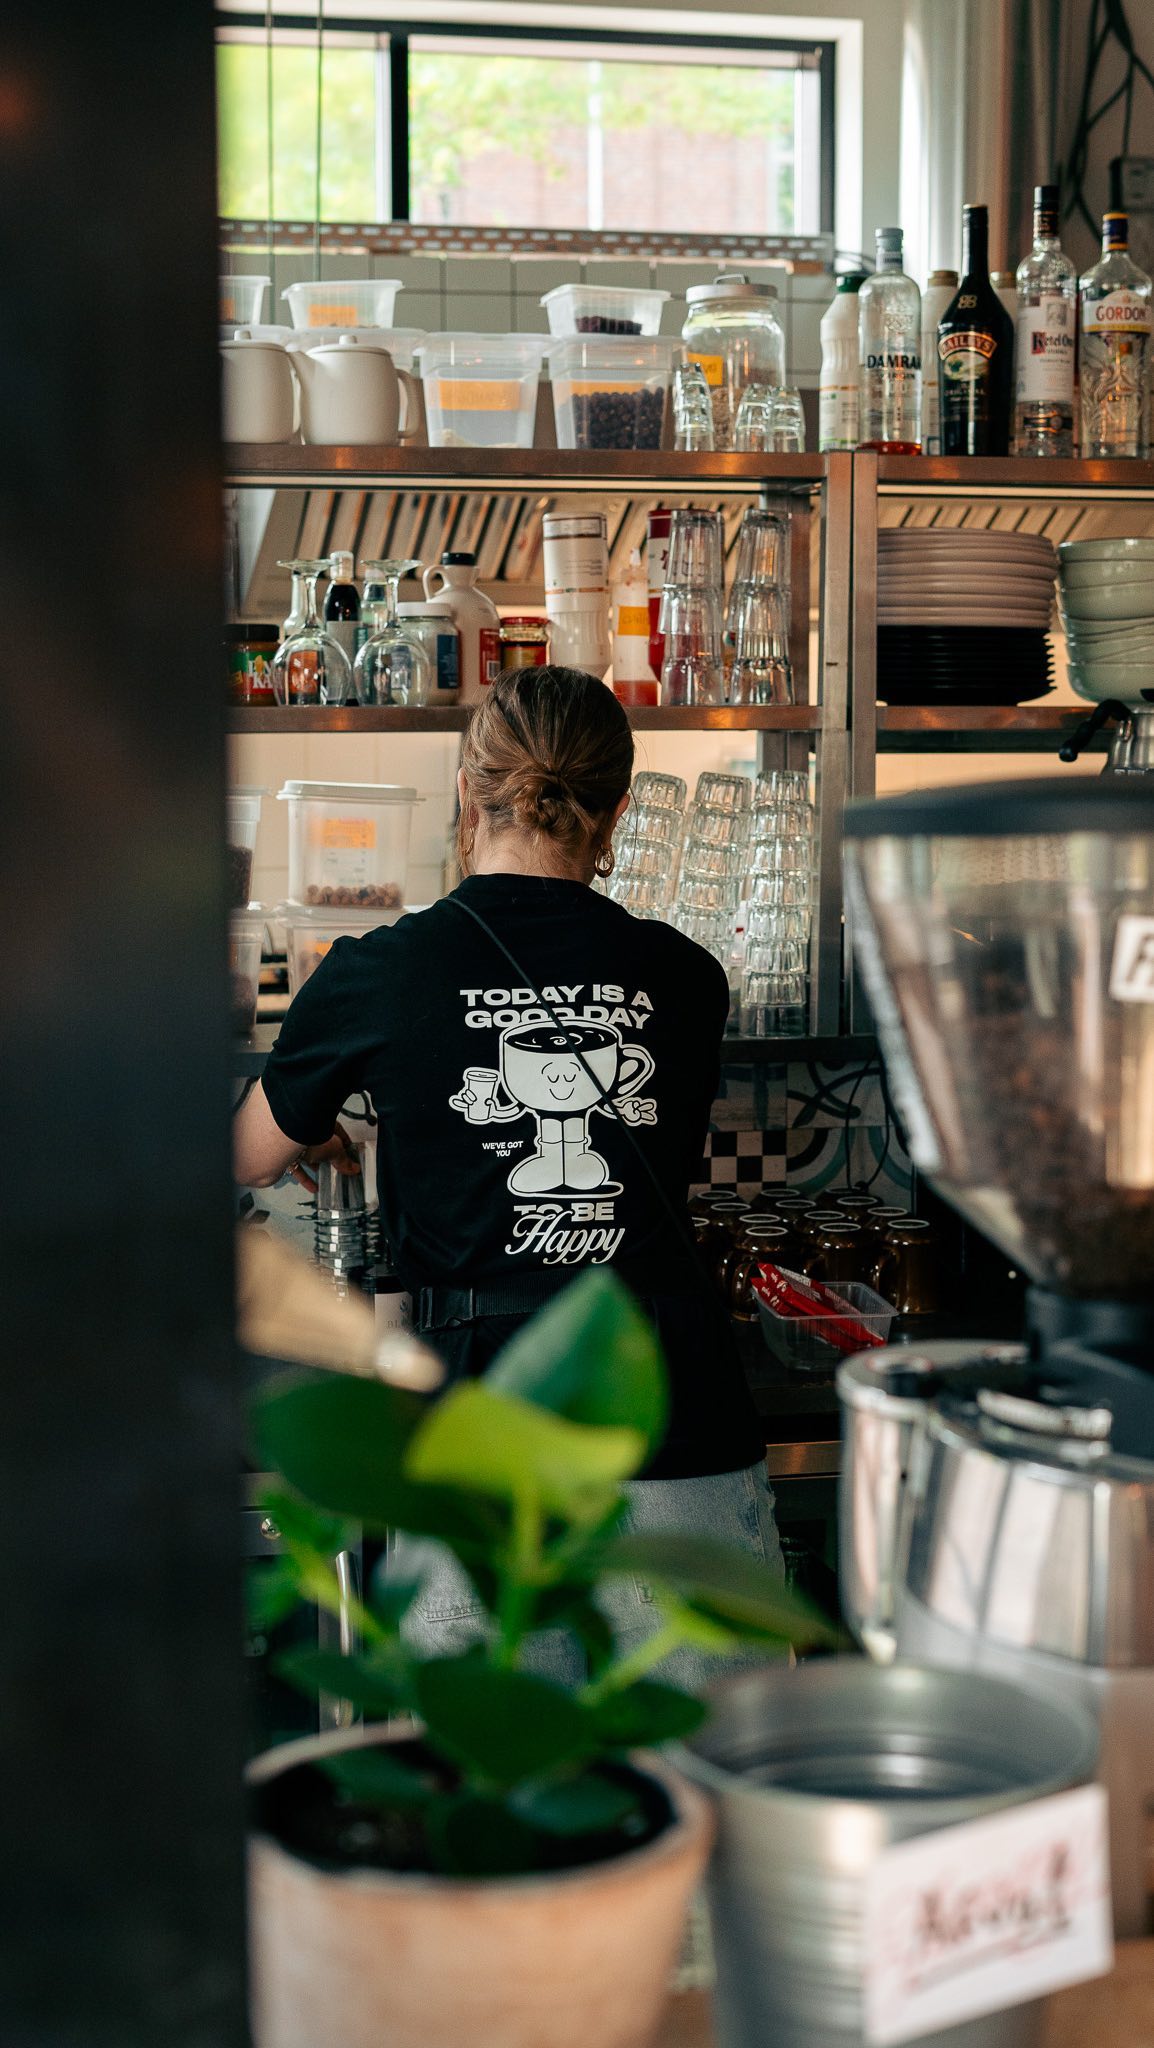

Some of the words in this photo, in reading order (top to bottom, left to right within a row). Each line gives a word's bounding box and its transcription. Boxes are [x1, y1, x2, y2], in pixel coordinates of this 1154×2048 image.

[459, 984, 584, 1007] TODAY
[592, 984, 625, 1003] IS
[631, 990, 654, 1011] A
[464, 1008, 576, 1029] GOOD
[583, 1005, 651, 1030] DAY
[481, 1141, 506, 1150] WE'VE
[507, 1140, 524, 1149] GOT
[495, 1149, 511, 1158] YOU
[571, 1201, 615, 1222] BE
[504, 1210, 626, 1265] Happy
